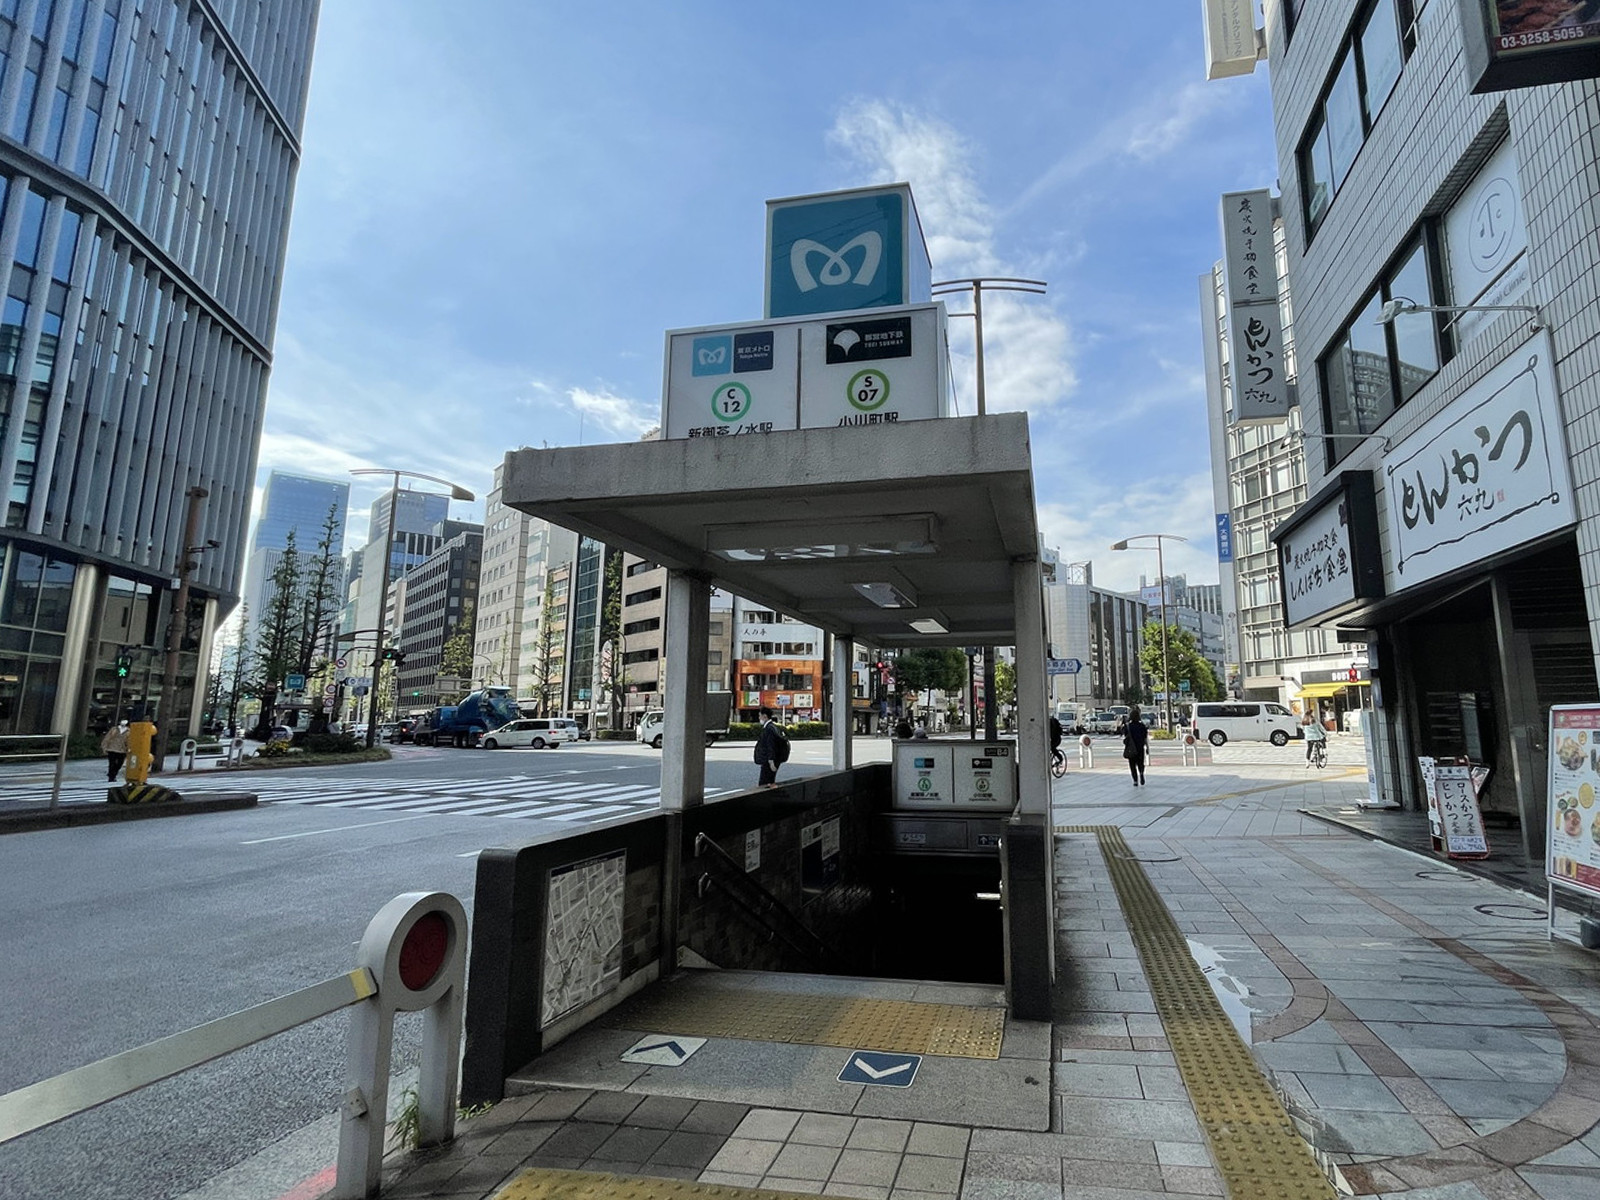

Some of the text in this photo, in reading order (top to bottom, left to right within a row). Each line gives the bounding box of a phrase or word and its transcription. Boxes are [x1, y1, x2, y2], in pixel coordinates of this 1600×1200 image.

[1501, 27, 1584, 48] 03-3258-5055
[1503, 269, 1528, 296] Clinic
[737, 345, 770, 354] 東京メトロ
[1244, 316, 1274, 386] とんかつ
[864, 376, 873, 388] S
[727, 388, 736, 400] C
[858, 388, 879, 402] 07
[723, 400, 741, 413] 12
[836, 411, 899, 427] 小川町駅
[1401, 409, 1533, 530] とんかつ
